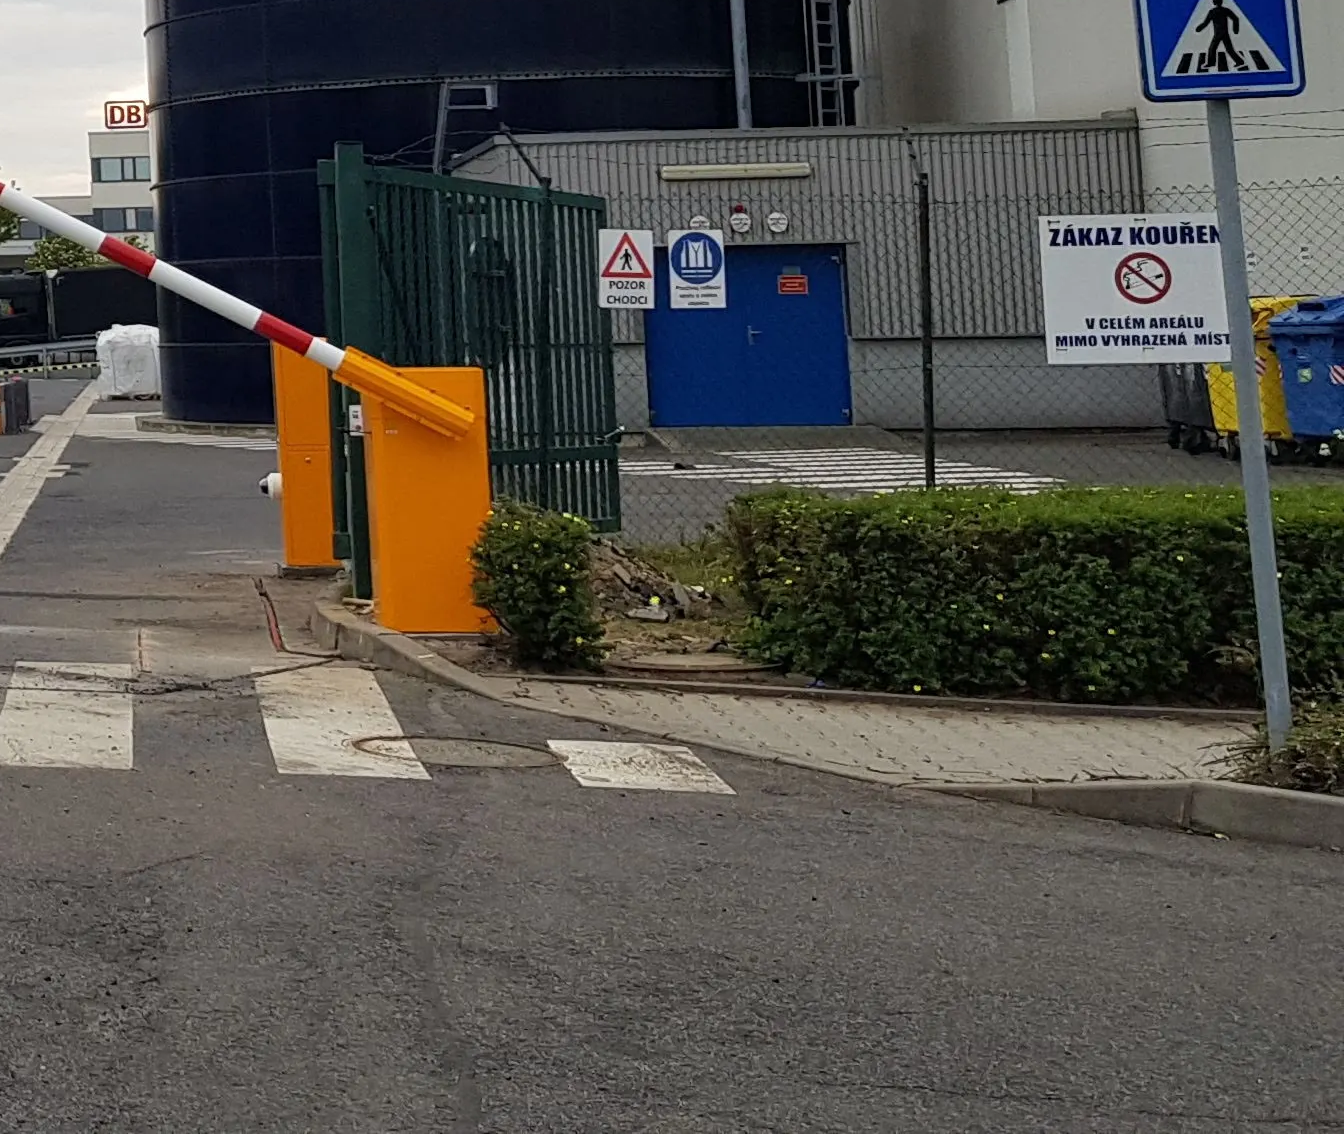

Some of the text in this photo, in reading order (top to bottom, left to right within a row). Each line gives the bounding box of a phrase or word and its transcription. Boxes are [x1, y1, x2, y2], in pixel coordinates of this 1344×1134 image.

[109, 105, 142, 124] DB
[1049, 222, 1221, 247] ZÁKAZ KOUŘEN
[609, 280, 646, 290] POZOR
[606, 295, 648, 305] CHODCI
[1085, 314, 1204, 330] V CELÉM AREÁLU
[1055, 332, 1231, 348] MIMO VYHRAZENÁ MÍST
